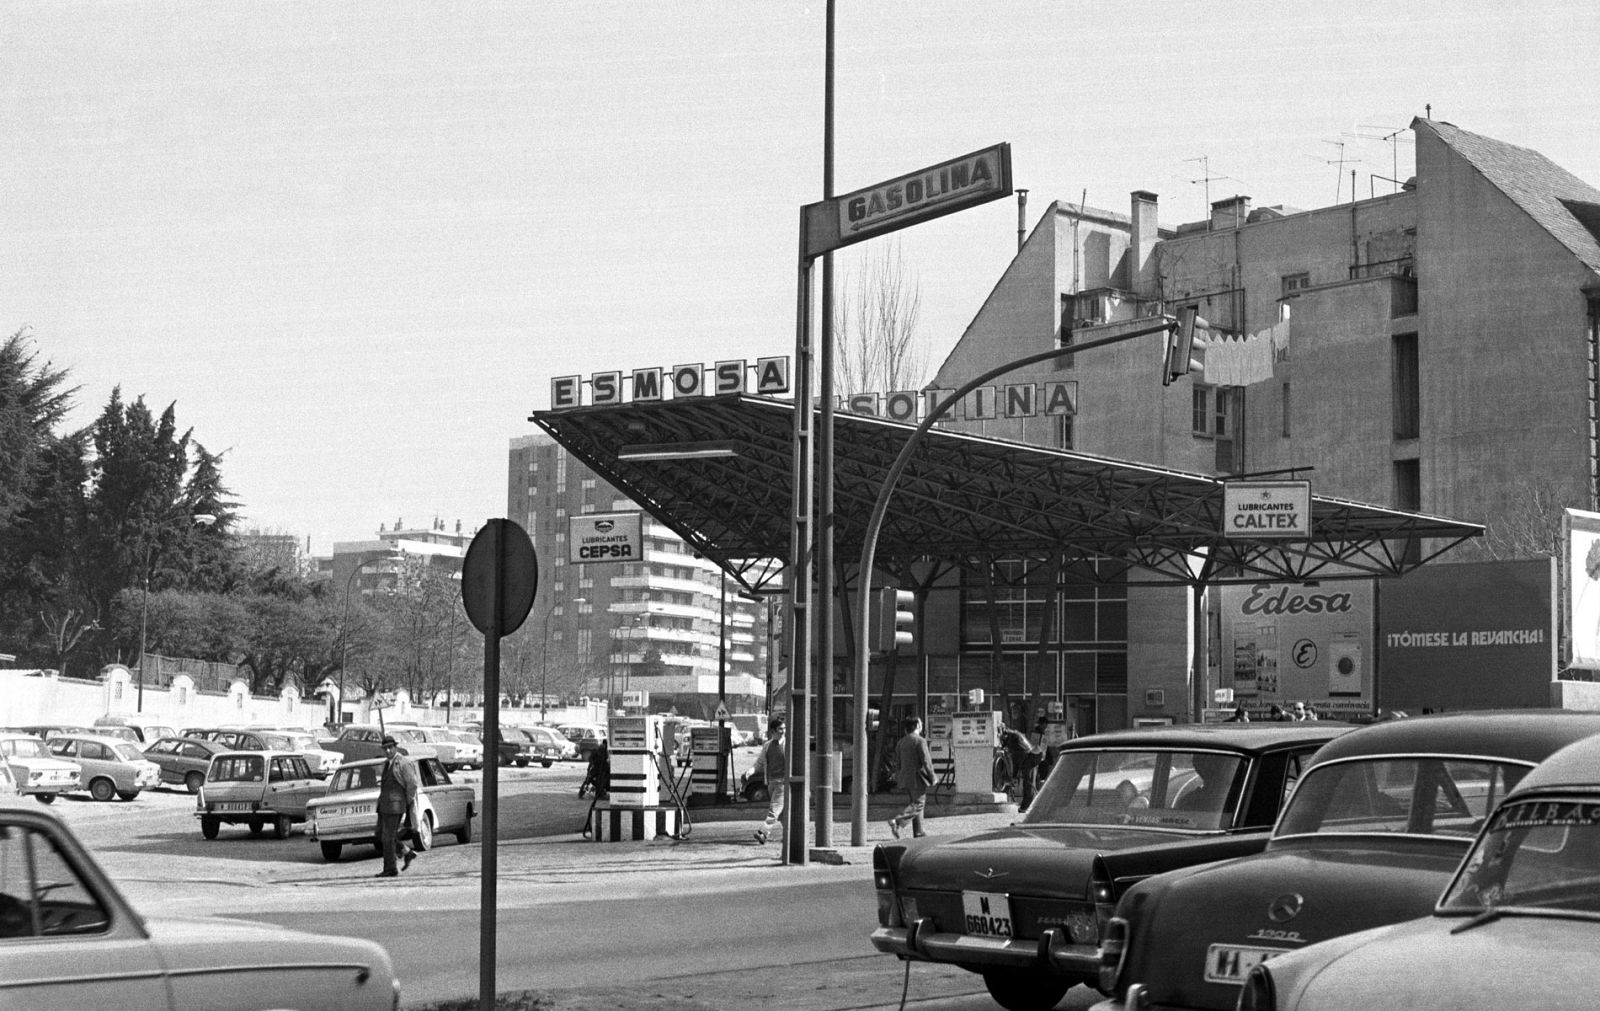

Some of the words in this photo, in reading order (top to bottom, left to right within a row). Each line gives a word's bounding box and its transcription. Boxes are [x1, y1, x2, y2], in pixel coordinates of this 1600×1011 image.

[848, 157, 992, 222] GASOLINA
[555, 361, 784, 405] ESMOSA
[1238, 503, 1294, 511] LUBRICANTES
[1233, 513, 1298, 528] CALTEX
[582, 535, 628, 544] LUBRICANTES
[580, 544, 631, 558] CEPSA
[1242, 583, 1352, 615] Edesa
[1453, 632, 1468, 646] LA
[1471, 629, 1544, 645] REVANCHA!
